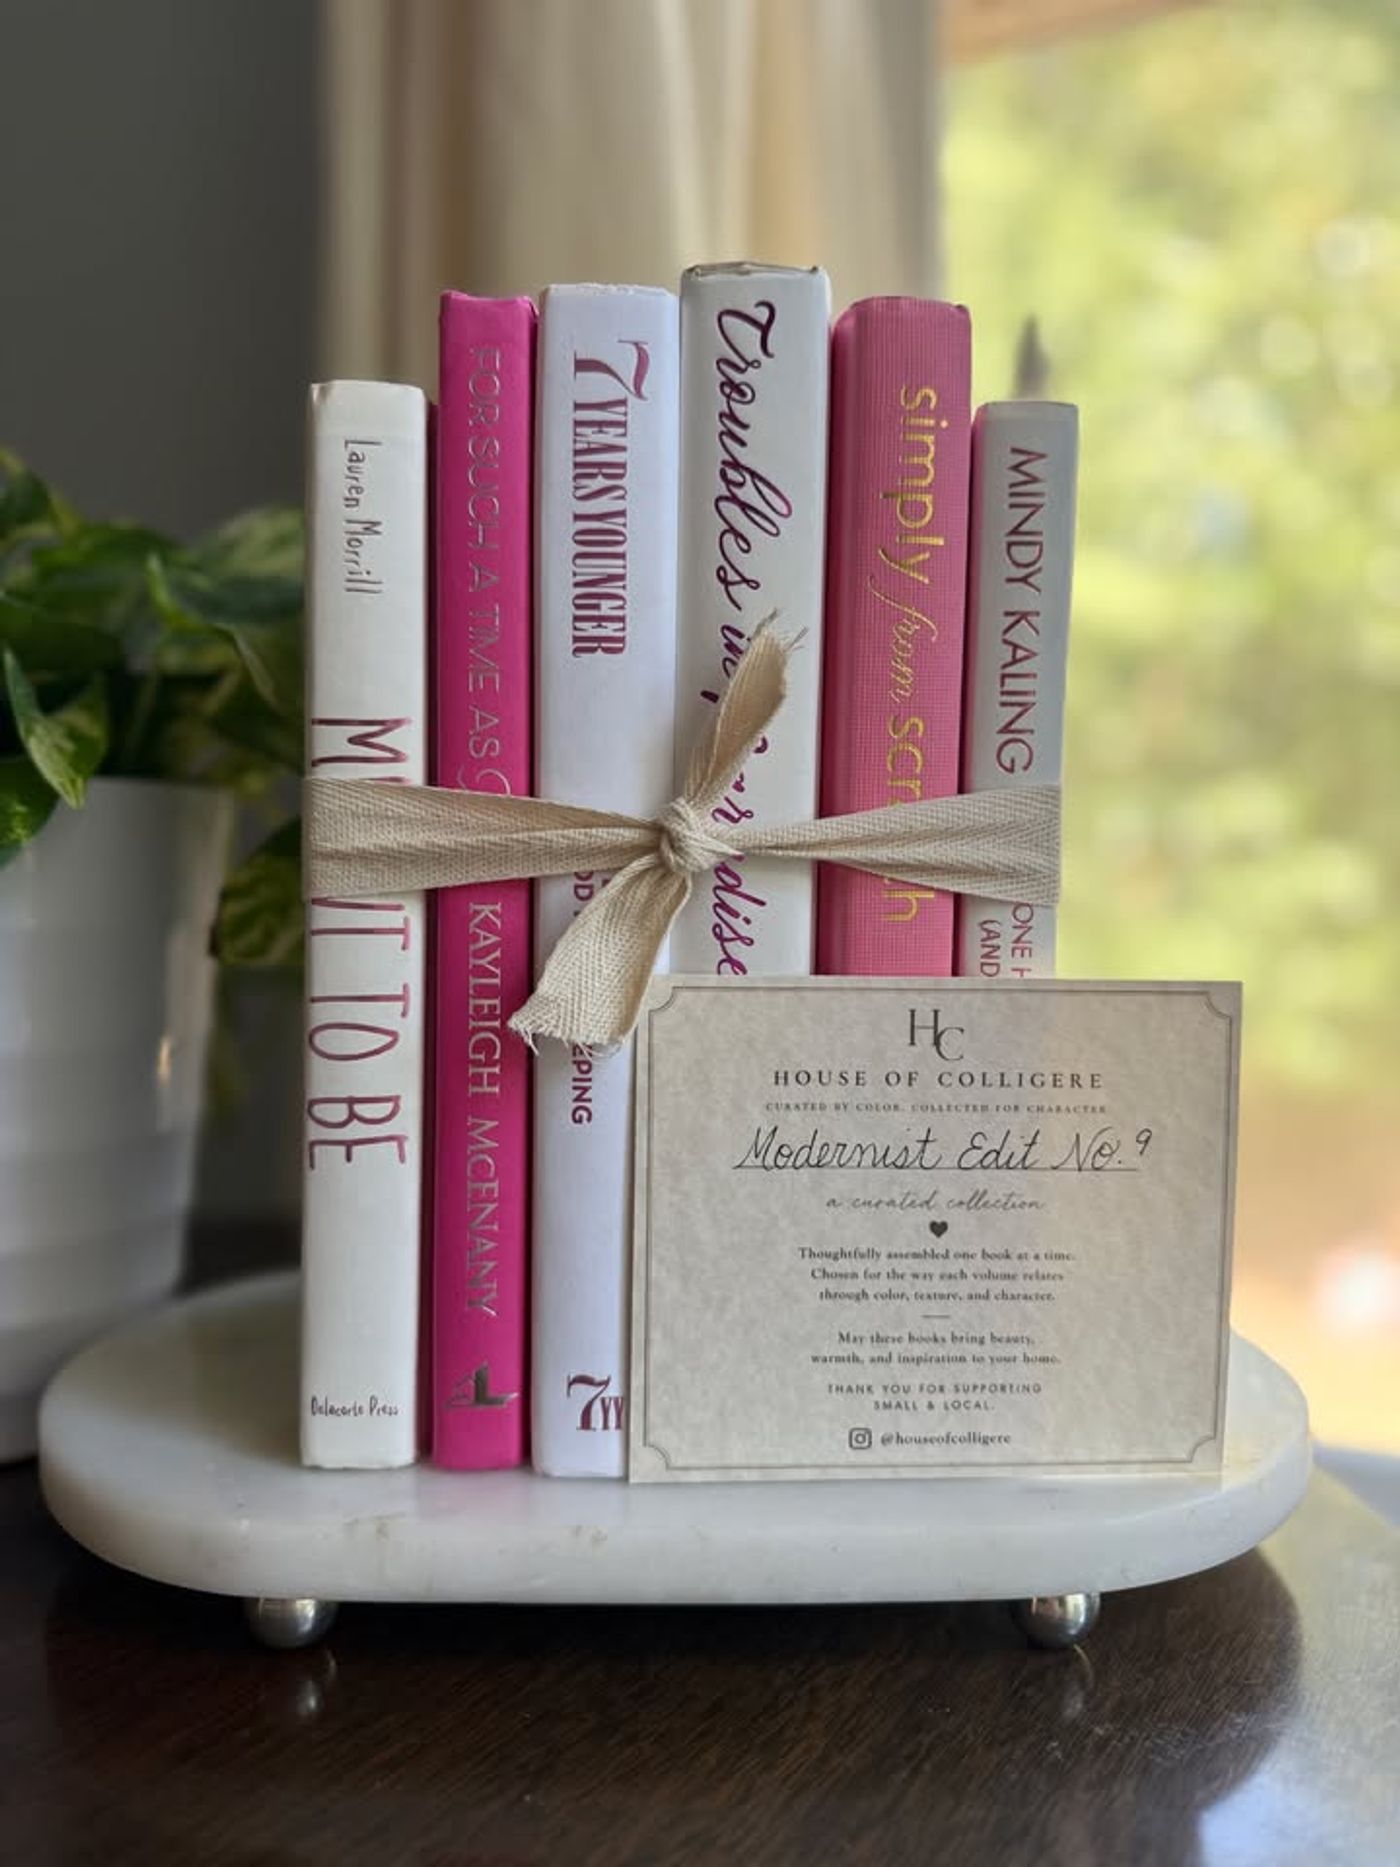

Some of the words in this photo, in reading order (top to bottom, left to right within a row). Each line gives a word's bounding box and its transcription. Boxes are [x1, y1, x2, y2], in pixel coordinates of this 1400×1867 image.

[468, 348, 501, 427] FOR
[574, 339, 649, 400] 7
[344, 439, 383, 509] Lauren
[572, 399, 628, 501] YEARS
[715, 300, 792, 611] Troubles
[468, 436, 501, 550] SUCH
[878, 385, 948, 584] simply
[1004, 446, 1048, 594] MINDY
[344, 519, 383, 594] Morrill
[468, 562, 501, 592] A
[571, 508, 628, 658] YOUNGER
[468, 603, 501, 693] TIME
[867, 574, 938, 704] from
[995, 610, 1041, 774] KALING
[468, 704, 501, 758] AS
[979, 919, 1002, 977] (AND
[308, 982, 411, 1061] TO
[468, 902, 502, 1098] KAYLEIGH
[766, 1102, 828, 1112] CURATED
[834, 1102, 849, 1112] BY
[911, 1104, 989, 1113] COLLECTED
[995, 1104, 1019, 1113] FOR
[1027, 1104, 1106, 1114] CHARACTER
[774, 1069, 867, 1087] HOUSE
[885, 1070, 919, 1087] OF
[938, 1070, 1104, 1089] COLLIGERE
[306, 1095, 409, 1171] BE
[735, 1125, 942, 1171] Modernist
[957, 1128, 1040, 1171] Edit
[1051, 1126, 1122, 1172] No.
[1136, 1128, 1153, 1156] 9
[467, 1114, 500, 1317] MCENANY
[826, 1198, 841, 1209] a
[851, 1190, 938, 1210] curated
[947, 1188, 1045, 1211] collection
[798, 1246, 881, 1261] Thoughtfully
[886, 1247, 950, 1259] assembled
[953, 1252, 976, 1260] one
[981, 1248, 1011, 1260] book
[1016, 1250, 1028, 1260] at
[810, 1266, 859, 1279] Chosen
[863, 1267, 881, 1280] for
[886, 1267, 904, 1280] the
[909, 1271, 933, 1281] way
[938, 1268, 968, 1280] each
[971, 1268, 1018, 1280] volume
[1021, 1269, 1064, 1281] relates
[818, 1288, 869, 1303] through
[873, 1288, 910, 1301] color,
[966, 1289, 990, 1301] and
[838, 1332, 863, 1345] May
[870, 1331, 903, 1344] these
[908, 1332, 946, 1344] books
[951, 1332, 985, 1346] bring
[990, 1333, 1036, 1346] beauty,
[869, 1351, 892, 1364] and
[898, 1352, 967, 1366] inspiration
[972, 1354, 986, 1364] to
[989, 1355, 1018, 1366] your
[369, 1395, 399, 1417] Press
[828, 1384, 874, 1395] THANK
[882, 1384, 911, 1394] YOU
[919, 1384, 945, 1394] FOR
[953, 1383, 1042, 1395] SUPPORTING
[873, 1400, 917, 1411] SMALL
[927, 1400, 936, 1411] &
[943, 1400, 995, 1411] LOCAL.
[880, 1431, 1011, 1446] @houseofcolligere
